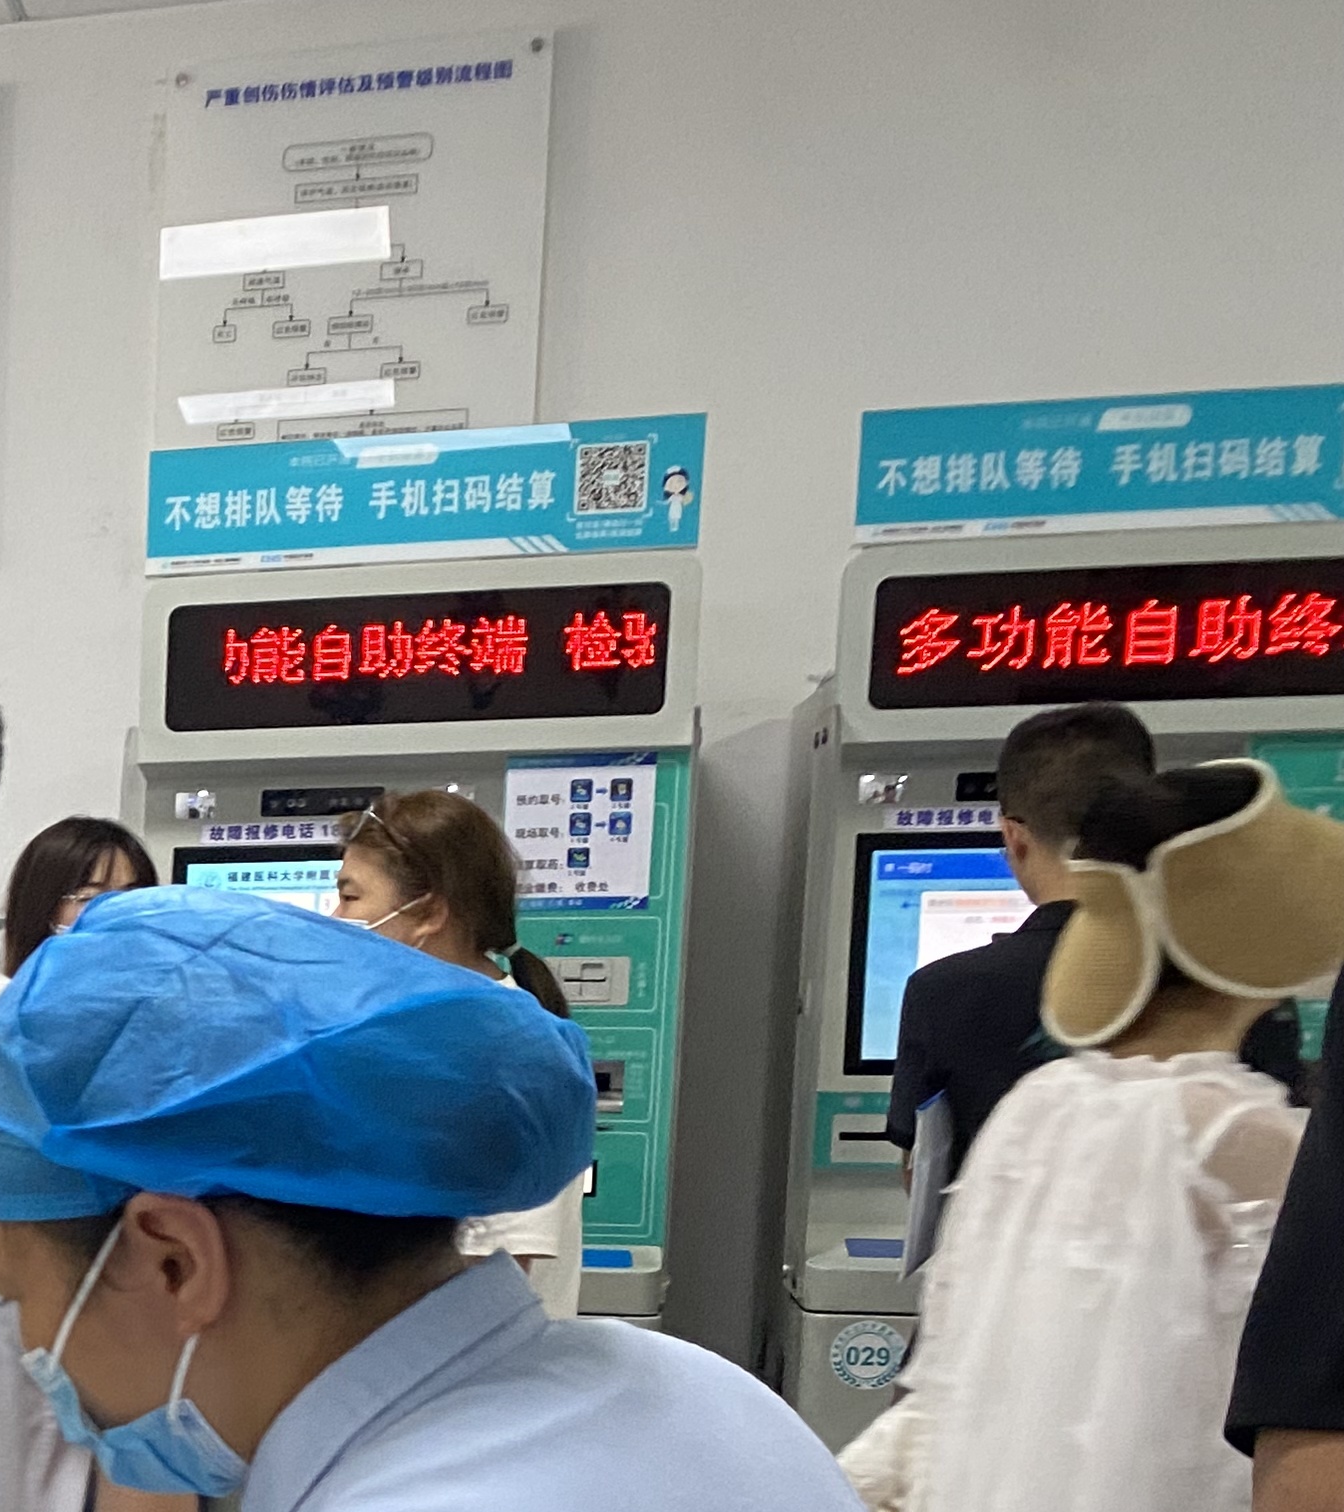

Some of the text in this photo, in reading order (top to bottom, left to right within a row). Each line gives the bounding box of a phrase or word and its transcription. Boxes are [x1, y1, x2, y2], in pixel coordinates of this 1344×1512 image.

[877, 434, 1325, 497] 不想排队等待 手机扫码结算
[164, 469, 557, 532] 不想排队等待 手机扫码结算
[209, 823, 315, 841] 故障报修电话
[575, 881, 609, 892] 收费处
[845, 1346, 890, 1367] 029
